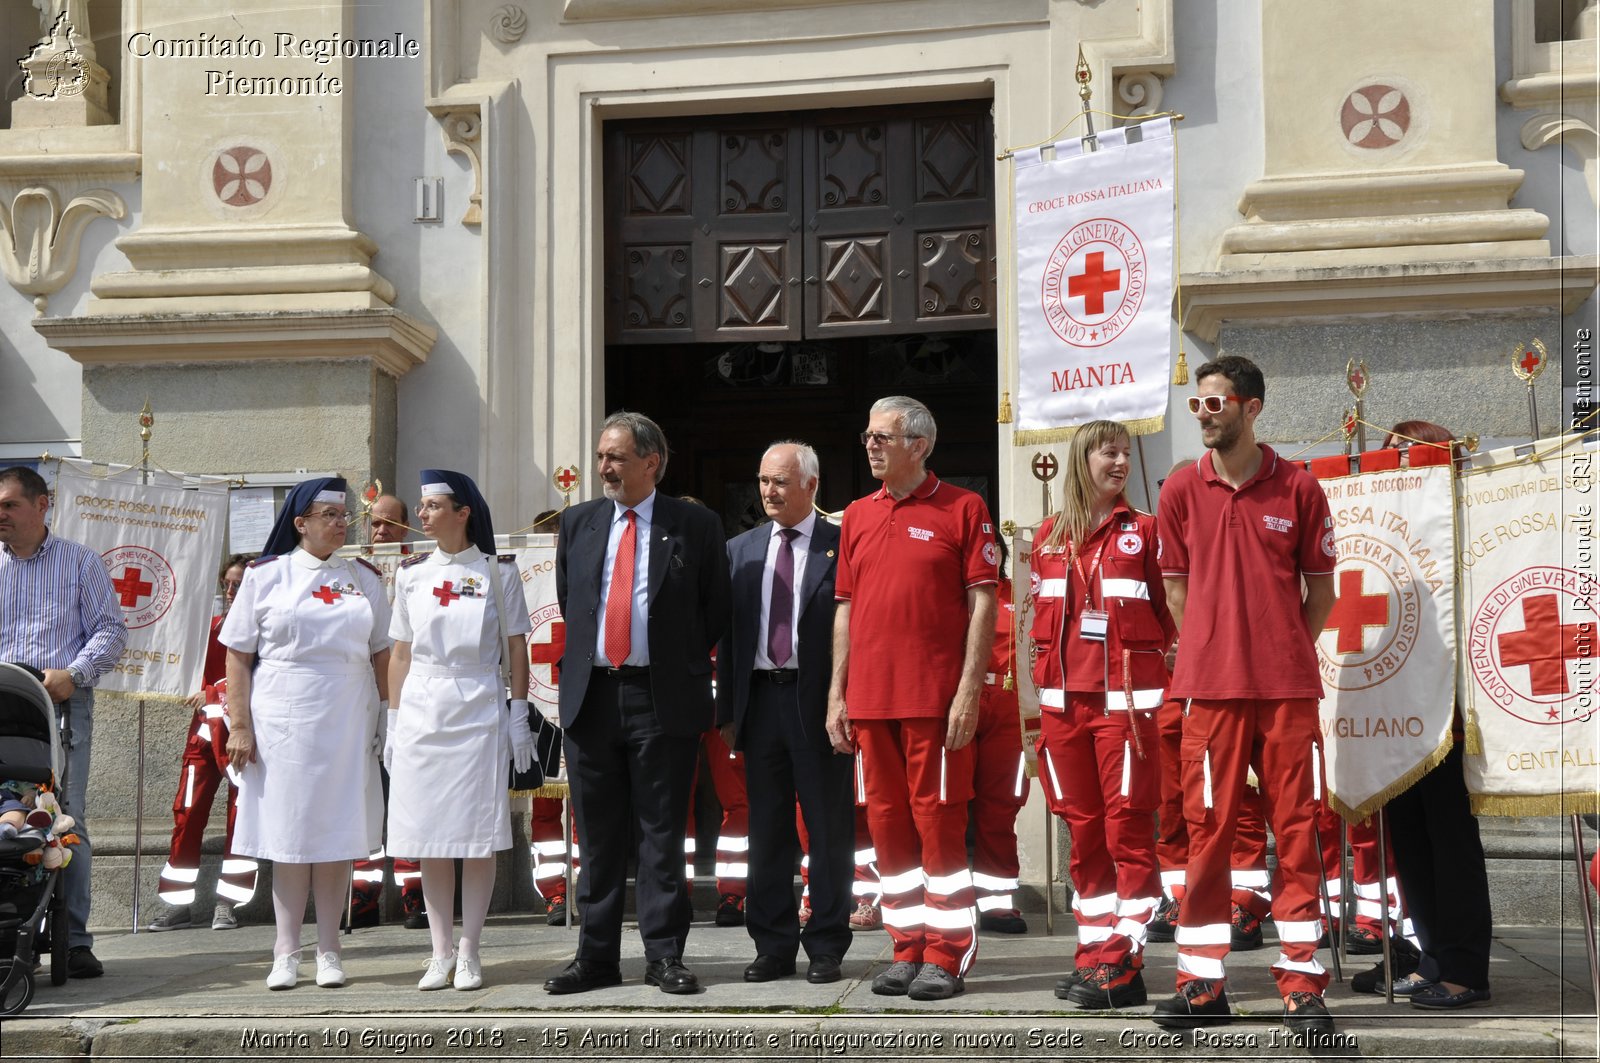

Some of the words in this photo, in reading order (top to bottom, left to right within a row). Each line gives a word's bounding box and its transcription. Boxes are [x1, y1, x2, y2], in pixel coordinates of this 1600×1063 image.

[1028, 196, 1065, 214] CROCE
[1067, 189, 1105, 206] ROSSA
[1107, 178, 1163, 199] ITALIANA
[1060, 240, 1074, 257] DI
[1072, 223, 1126, 248] GINEVRA
[1124, 242, 1139, 261] 22
[1046, 256, 1086, 342] CONVENZIONE
[1121, 260, 1144, 317] AGOSTO
[1101, 314, 1125, 340] 1864
[1051, 361, 1136, 393] MANTA
[1346, 481, 1366, 497] DEL
[1474, 481, 1537, 505] VOLONTARI
[1540, 478, 1562, 493] DEL
[74, 494, 115, 510] CROCE
[118, 501, 157, 515] ROSSA
[160, 504, 207, 521] ITALIANA
[80, 512, 121, 524] COMITATO
[120, 517, 150, 528] LOCALE
[1493, 512, 1558, 545] ROSSA
[114, 550, 154, 565] GINEVRA
[1379, 509, 1444, 596] ITALIANA
[154, 562, 166, 574] 22
[1392, 566, 1411, 588] 22
[154, 574, 171, 612] AGOSTO
[1395, 590, 1416, 653] AGOSTO
[1472, 601, 1514, 707] CONVENZIONE
[1493, 587, 1511, 606] DI
[1510, 570, 1576, 595] GINEVRA
[166, 652, 181, 665] DI
[1363, 651, 1400, 682] 1864
